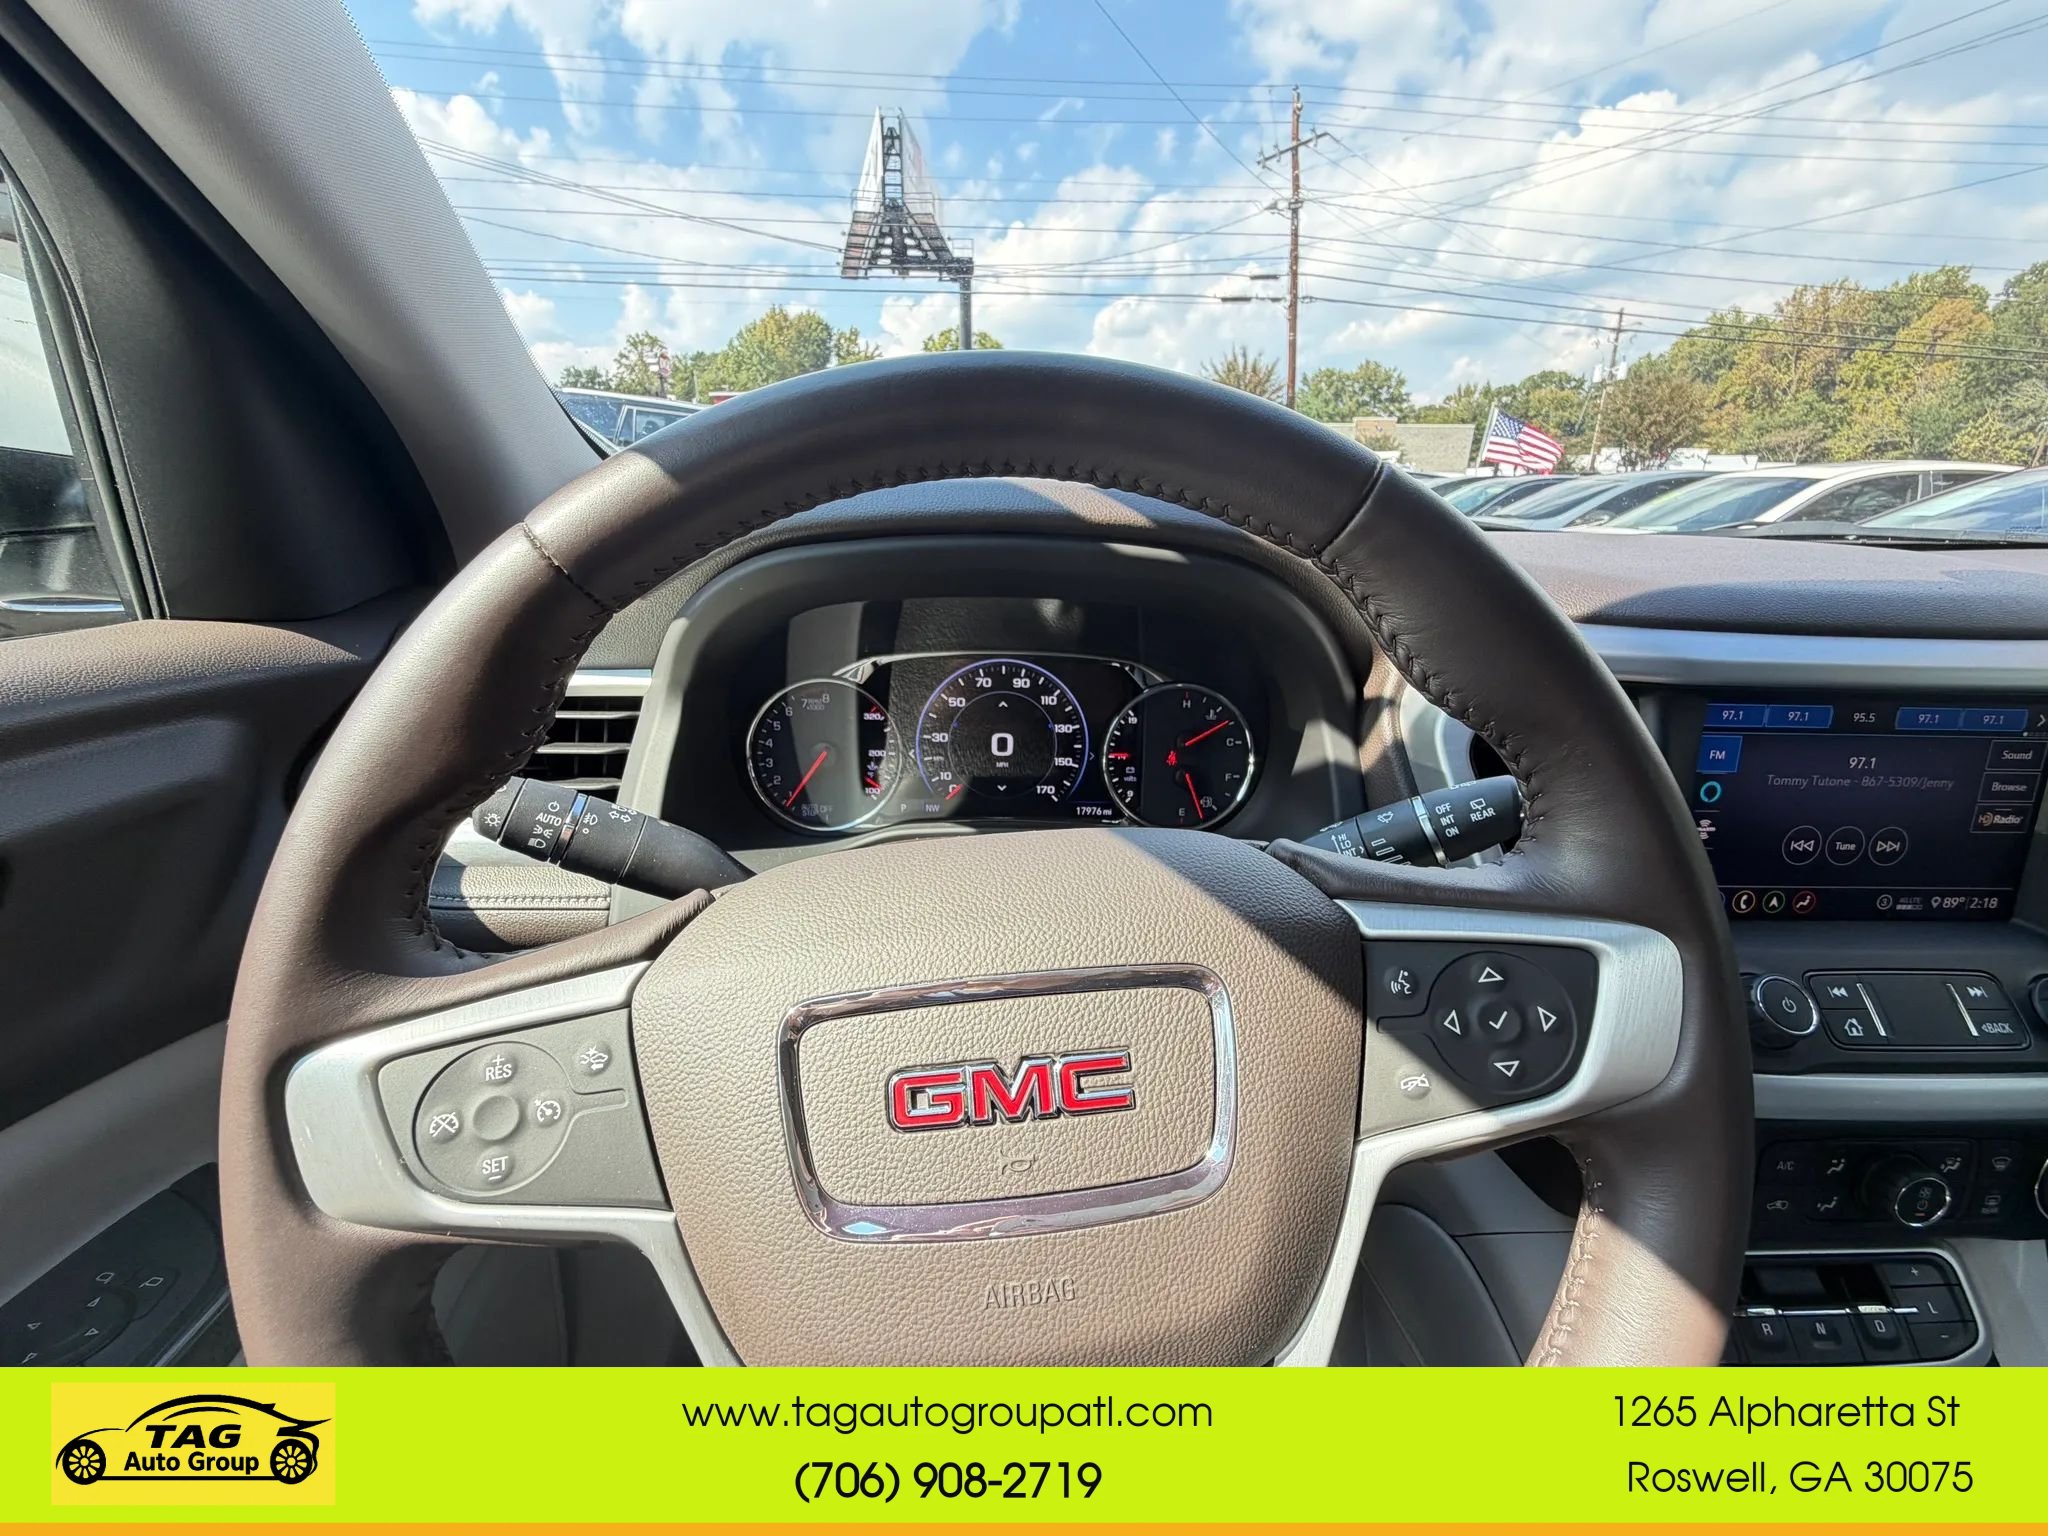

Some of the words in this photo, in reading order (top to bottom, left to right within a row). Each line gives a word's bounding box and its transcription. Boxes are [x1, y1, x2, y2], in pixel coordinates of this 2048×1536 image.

[975, 678, 992, 688] 70
[1012, 678, 1030, 688] 90
[822, 693, 830, 703] 8
[948, 697, 965, 707] 50
[1041, 696, 1057, 706] 110
[801, 698, 808, 709] 7
[1183, 700, 1191, 708] H
[785, 707, 792, 717] 6
[1722, 710, 1744, 720] 97.1
[1788, 711, 1809, 721] 97.1
[1853, 713, 1876, 723] 95.5
[1918, 714, 1940, 724] 97.1
[1983, 715, 2004, 725] 97.1
[773, 721, 781, 731] 5
[1055, 724, 1073, 733] 130
[765, 738, 773, 748] 4
[931, 733, 948, 743] 30
[1226, 738, 1234, 747] C
[991, 732, 1014, 757] 0
[868, 749, 886, 757] 200
[1709, 750, 1726, 760] FM
[2001, 750, 2032, 761] Sound
[766, 758, 773, 768] 3
[1054, 758, 1073, 767] 150
[1849, 757, 1876, 769] 97.1
[773, 775, 781, 785] 2
[940, 771, 952, 781] 10
[1225, 773, 1231, 781] F
[1767, 774, 1809, 789] Tommy
[1812, 775, 1851, 787] Tutone
[1861, 776, 1955, 791] 867-5309/Jenny
[1991, 782, 2028, 792] Browse
[1036, 785, 1055, 795] 170
[1127, 790, 1134, 798] 9
[900, 804, 907, 812] P
[925, 804, 940, 812] NW
[1076, 807, 1102, 816] 17976
[1179, 808, 1185, 816] E
[1435, 802, 1453, 815] OFF
[535, 812, 562, 827] AUTO
[1470, 807, 1496, 823] REAR
[1440, 814, 1455, 827] INT
[1445, 826, 1460, 838] ON
[1337, 833, 1347, 842] HI
[1340, 840, 1352, 849] LO
[1835, 842, 1856, 850] Tune
[1969, 897, 1998, 909] 2:18
[1986, 1022, 2013, 1033] BACK
[485, 1064, 512, 1081] RES
[887, 1046, 1136, 1133] GMC
[482, 1156, 508, 1175] SET
[1776, 1161, 1794, 1171] A/C
[985, 1277, 1076, 1310] AIRBAG
[1761, 1323, 1773, 1336] R
[1815, 1322, 1826, 1336] N
[1875, 1320, 1886, 1333] D
